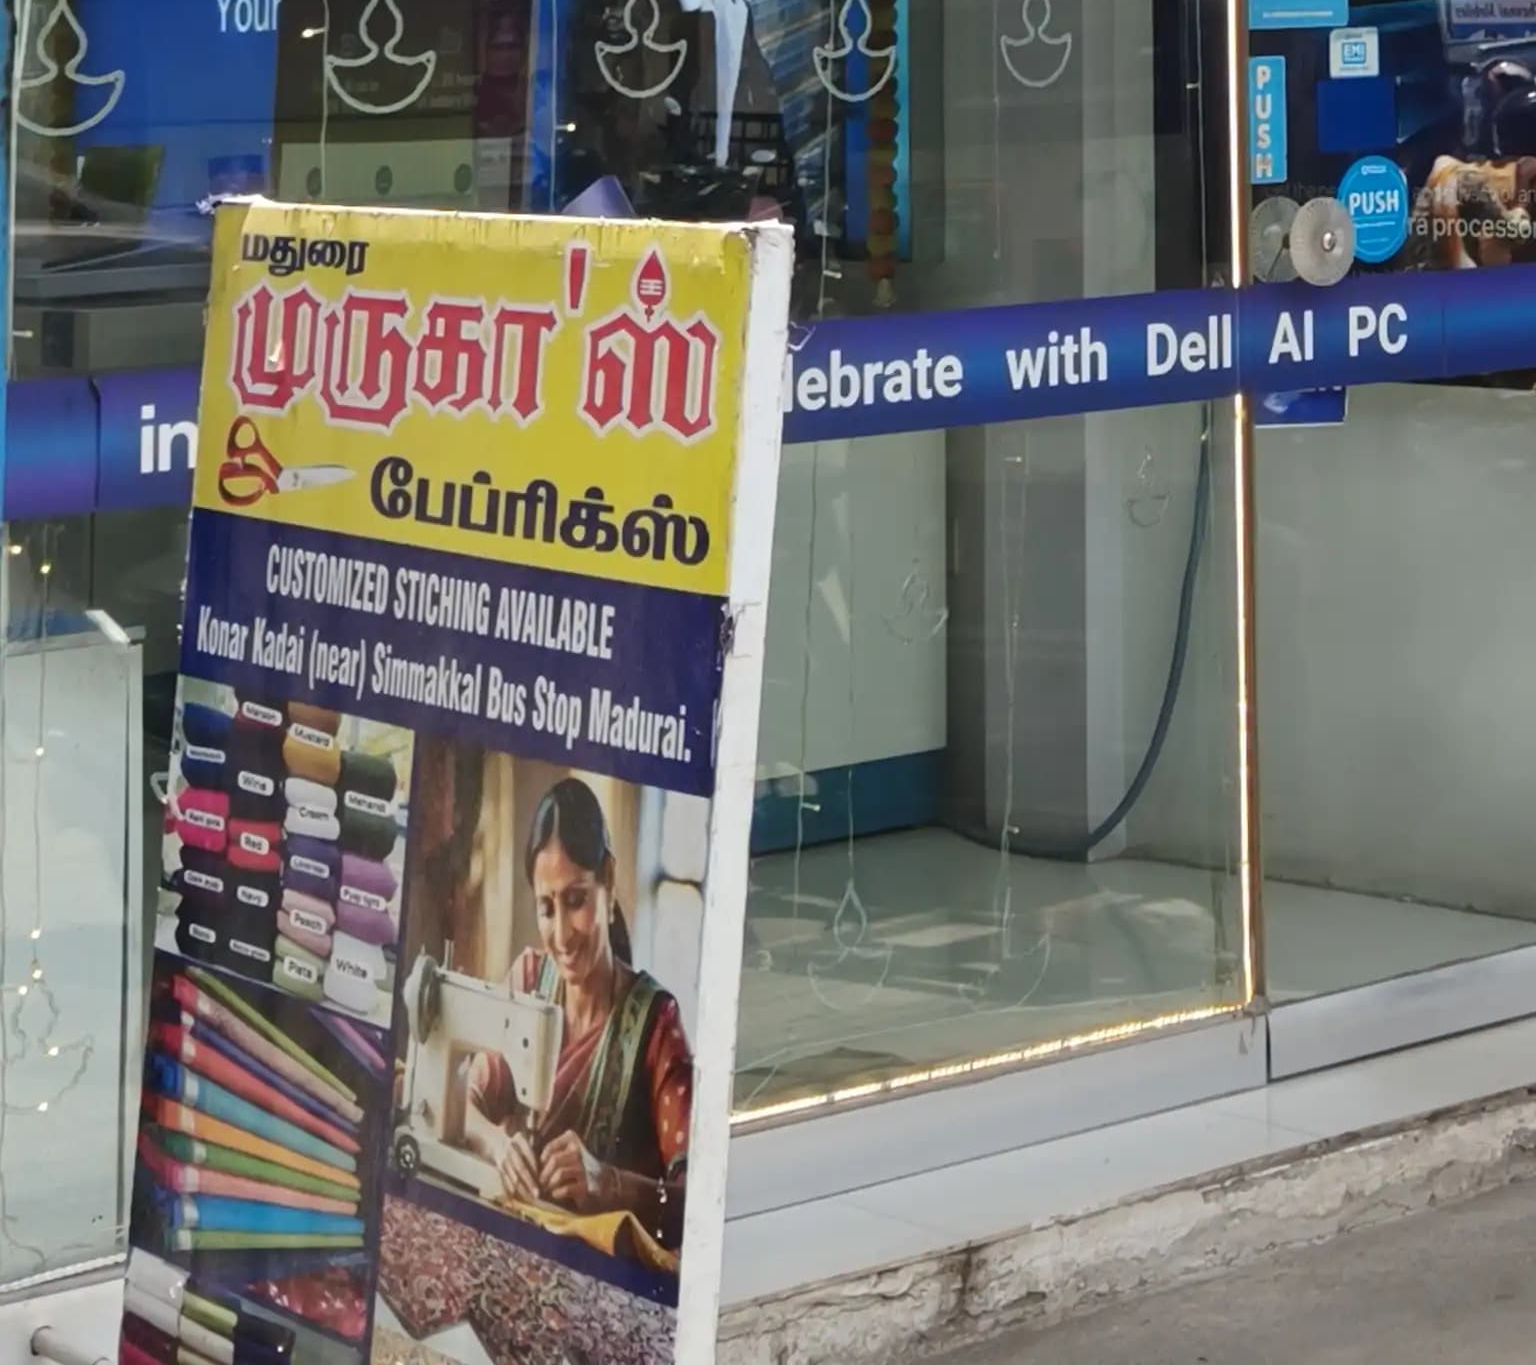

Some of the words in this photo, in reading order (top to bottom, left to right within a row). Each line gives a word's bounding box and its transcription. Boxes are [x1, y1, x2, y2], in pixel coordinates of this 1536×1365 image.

[1255, 64, 1274, 178] PUSH
[240, 230, 370, 276] மதுரை
[1350, 189, 1400, 216] PUSH
[783, 349, 963, 413] lebrate
[1006, 327, 1107, 390] with
[1146, 315, 1231, 376] Dell
[1268, 309, 1313, 364] AI
[1349, 303, 1407, 356] PC
[369, 454, 711, 567] பேப்ரிக்ஸ்
[267, 544, 389, 616] CUSTOMIZED
[394, 567, 488, 636] STICHING
[498, 582, 616, 662] AVAILABLE
[197, 605, 245, 663] Konar
[252, 625, 306, 676] Kadai
[309, 629, 367, 701] (near)
[371, 642, 481, 715] Simmakkal
[487, 670, 527, 720] Bus
[532, 678, 581, 735] Stop
[588, 687, 692, 763] Madurai.
